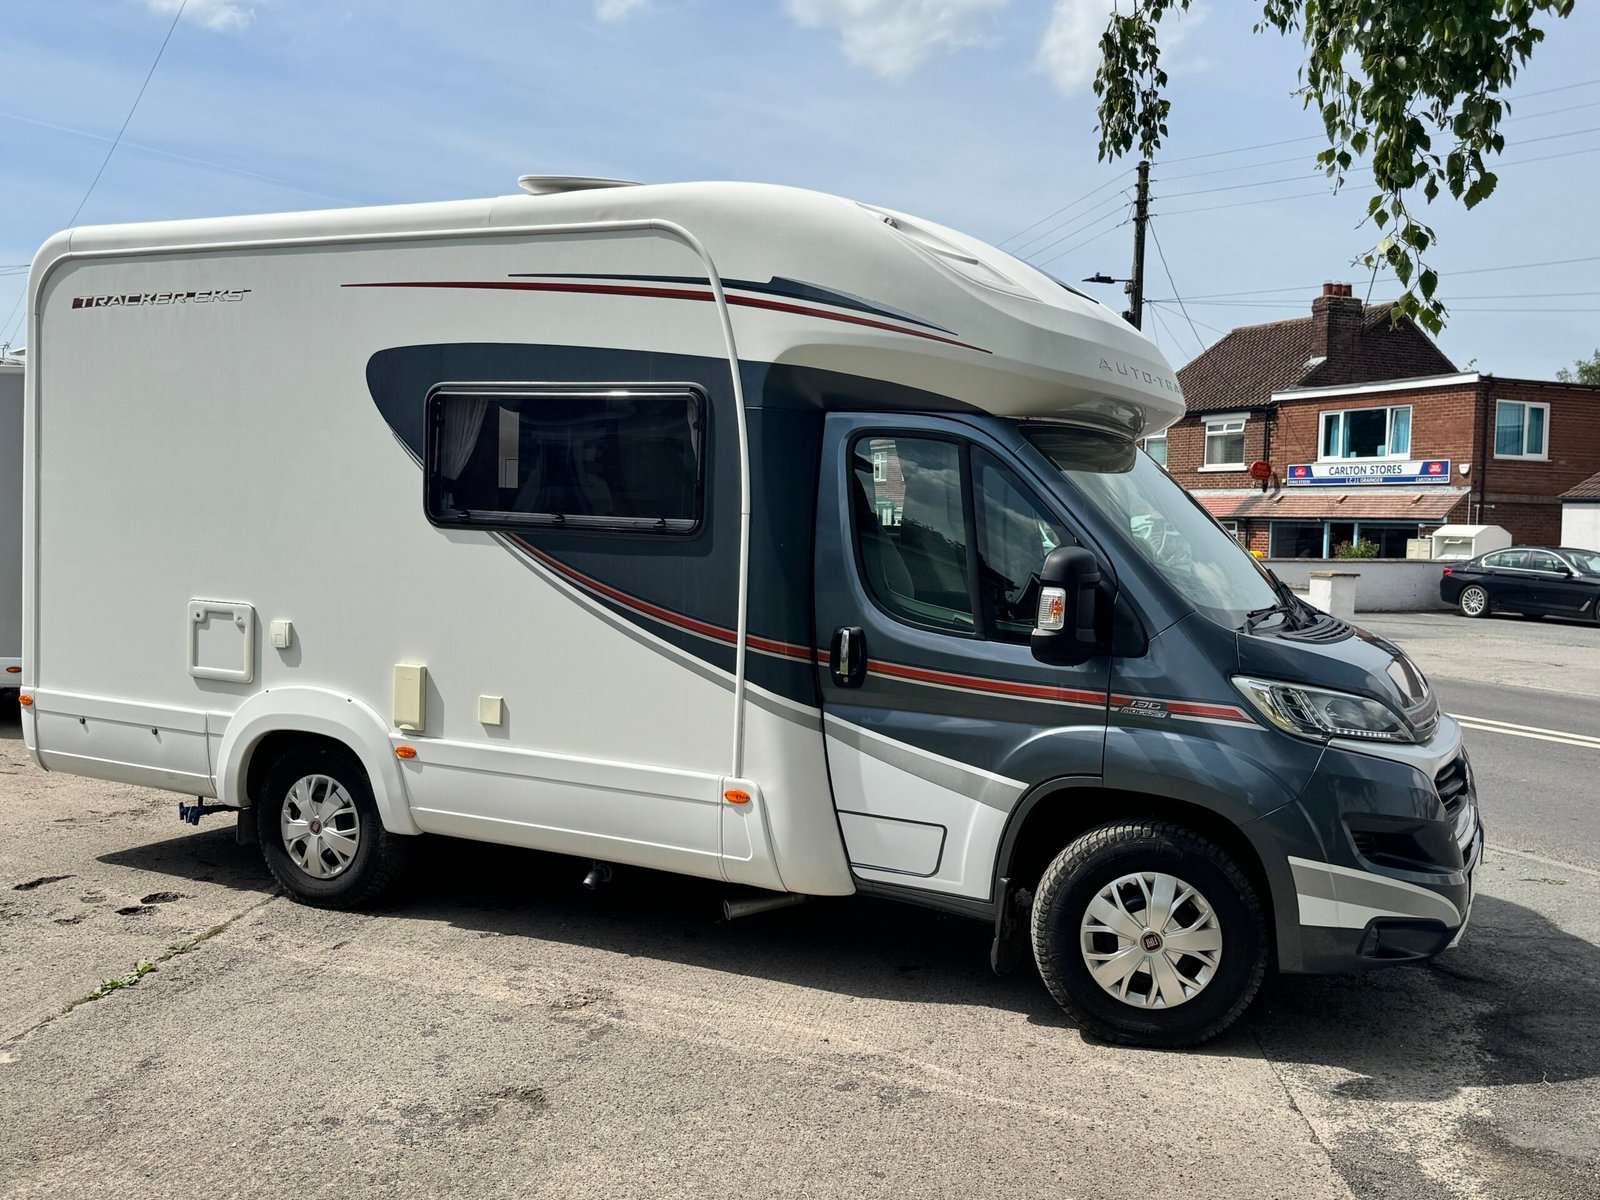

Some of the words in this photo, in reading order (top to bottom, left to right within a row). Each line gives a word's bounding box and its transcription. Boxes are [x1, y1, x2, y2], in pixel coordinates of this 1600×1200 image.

[78, 292, 187, 308] TRACKER
[1328, 465, 1367, 476] CARLTON
[1370, 464, 1402, 475] STORES
